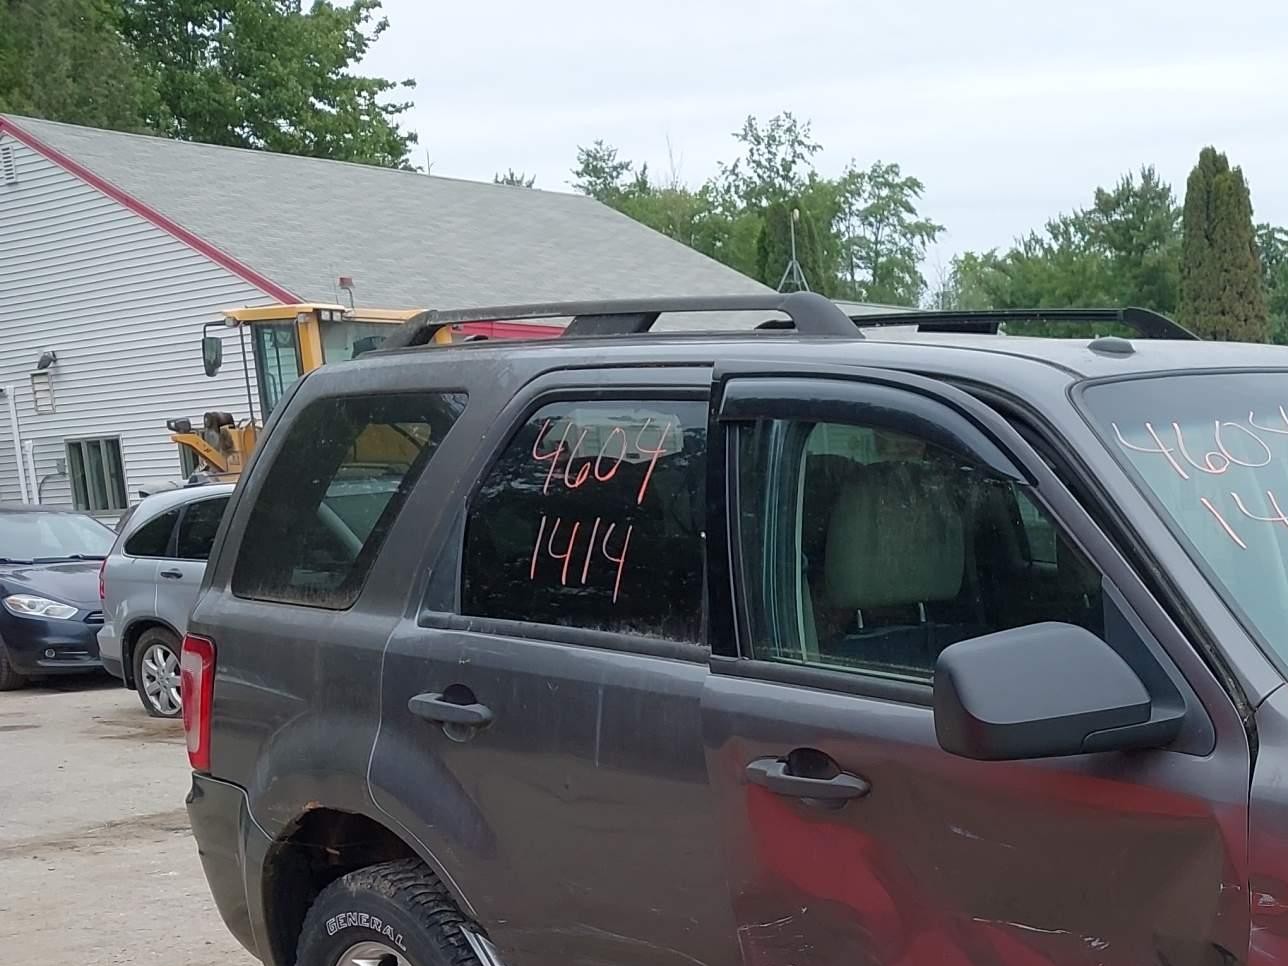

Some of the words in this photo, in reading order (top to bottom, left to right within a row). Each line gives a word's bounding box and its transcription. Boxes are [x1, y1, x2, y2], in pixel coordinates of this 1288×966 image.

[532, 418, 671, 505] 4604
[530, 515, 633, 604] 1414
[326, 911, 407, 952] GENERAL
